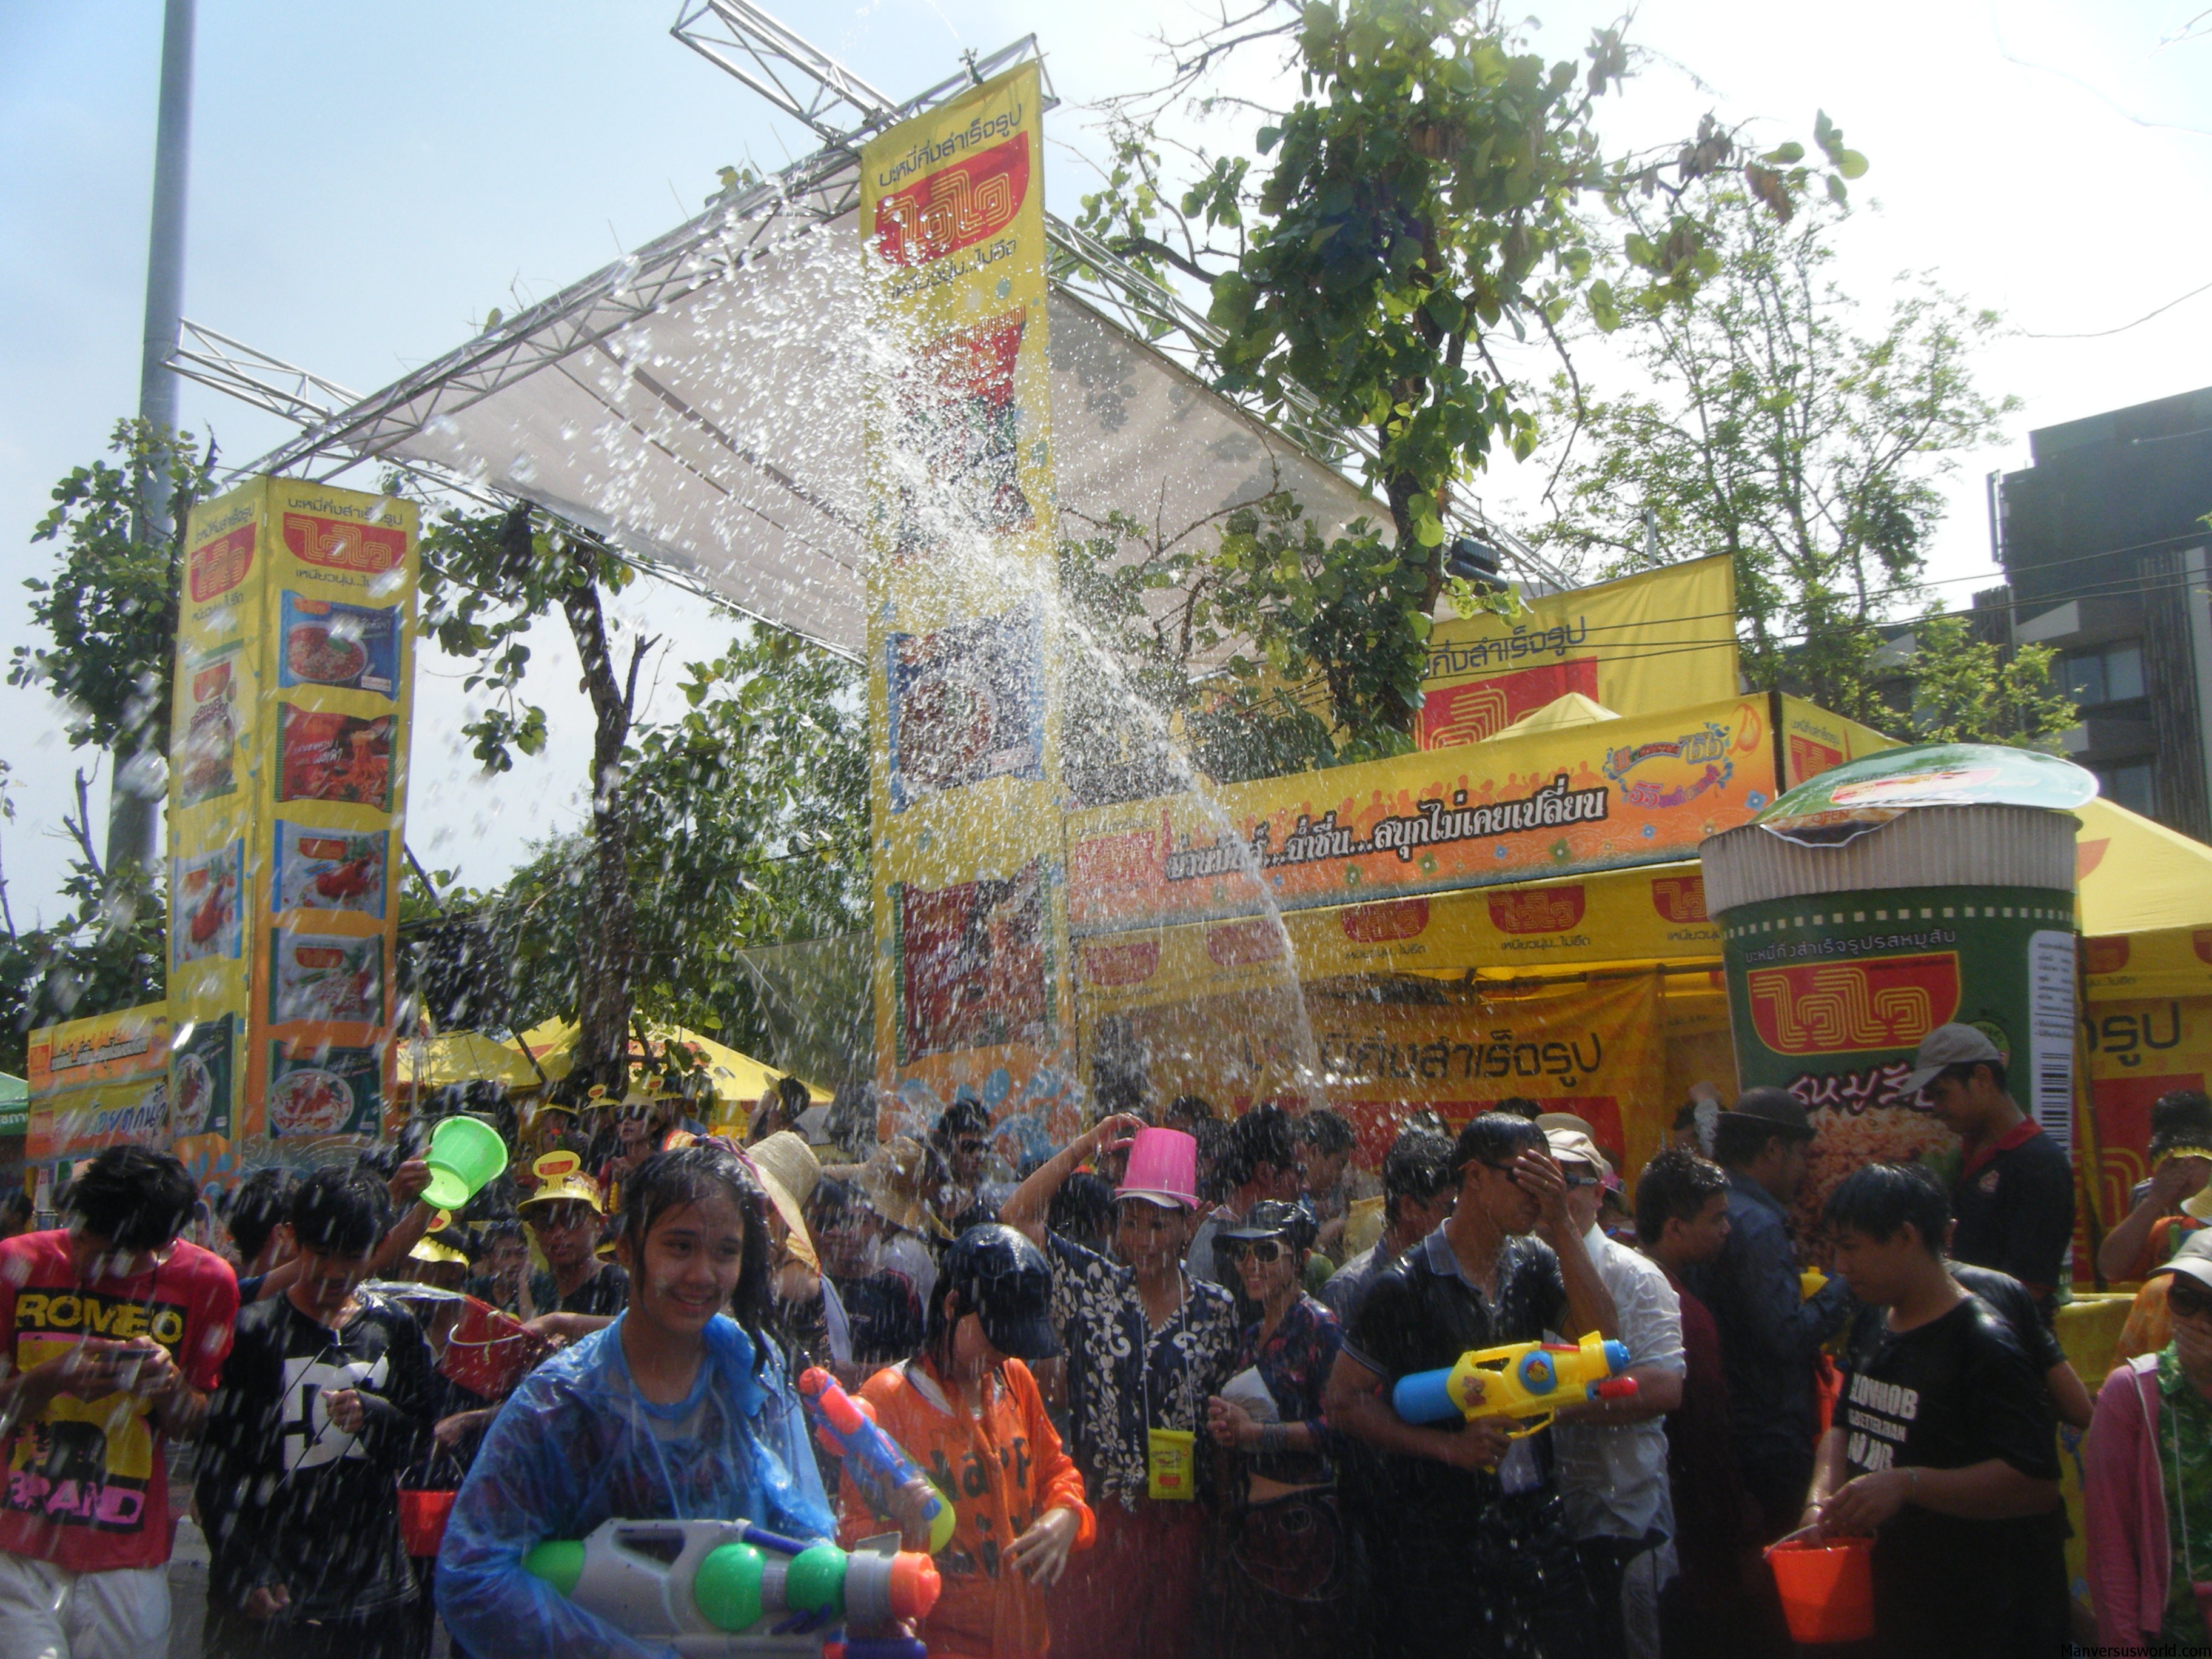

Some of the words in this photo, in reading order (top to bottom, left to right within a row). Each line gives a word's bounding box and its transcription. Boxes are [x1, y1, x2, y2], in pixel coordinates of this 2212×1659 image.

[879, 104, 1022, 187] บะหมี่กึ่งสำเร็จรูป
[882, 170, 1011, 261] ไวไว
[286, 517, 392, 570] ไวไว
[1811, 809, 1850, 823] OPEN
[1490, 890, 1574, 930] ไวไว
[1753, 968, 1932, 1047] ไวไว
[15, 1293, 183, 1344] ROMEO
[7, 1470, 146, 1524] BRAND
